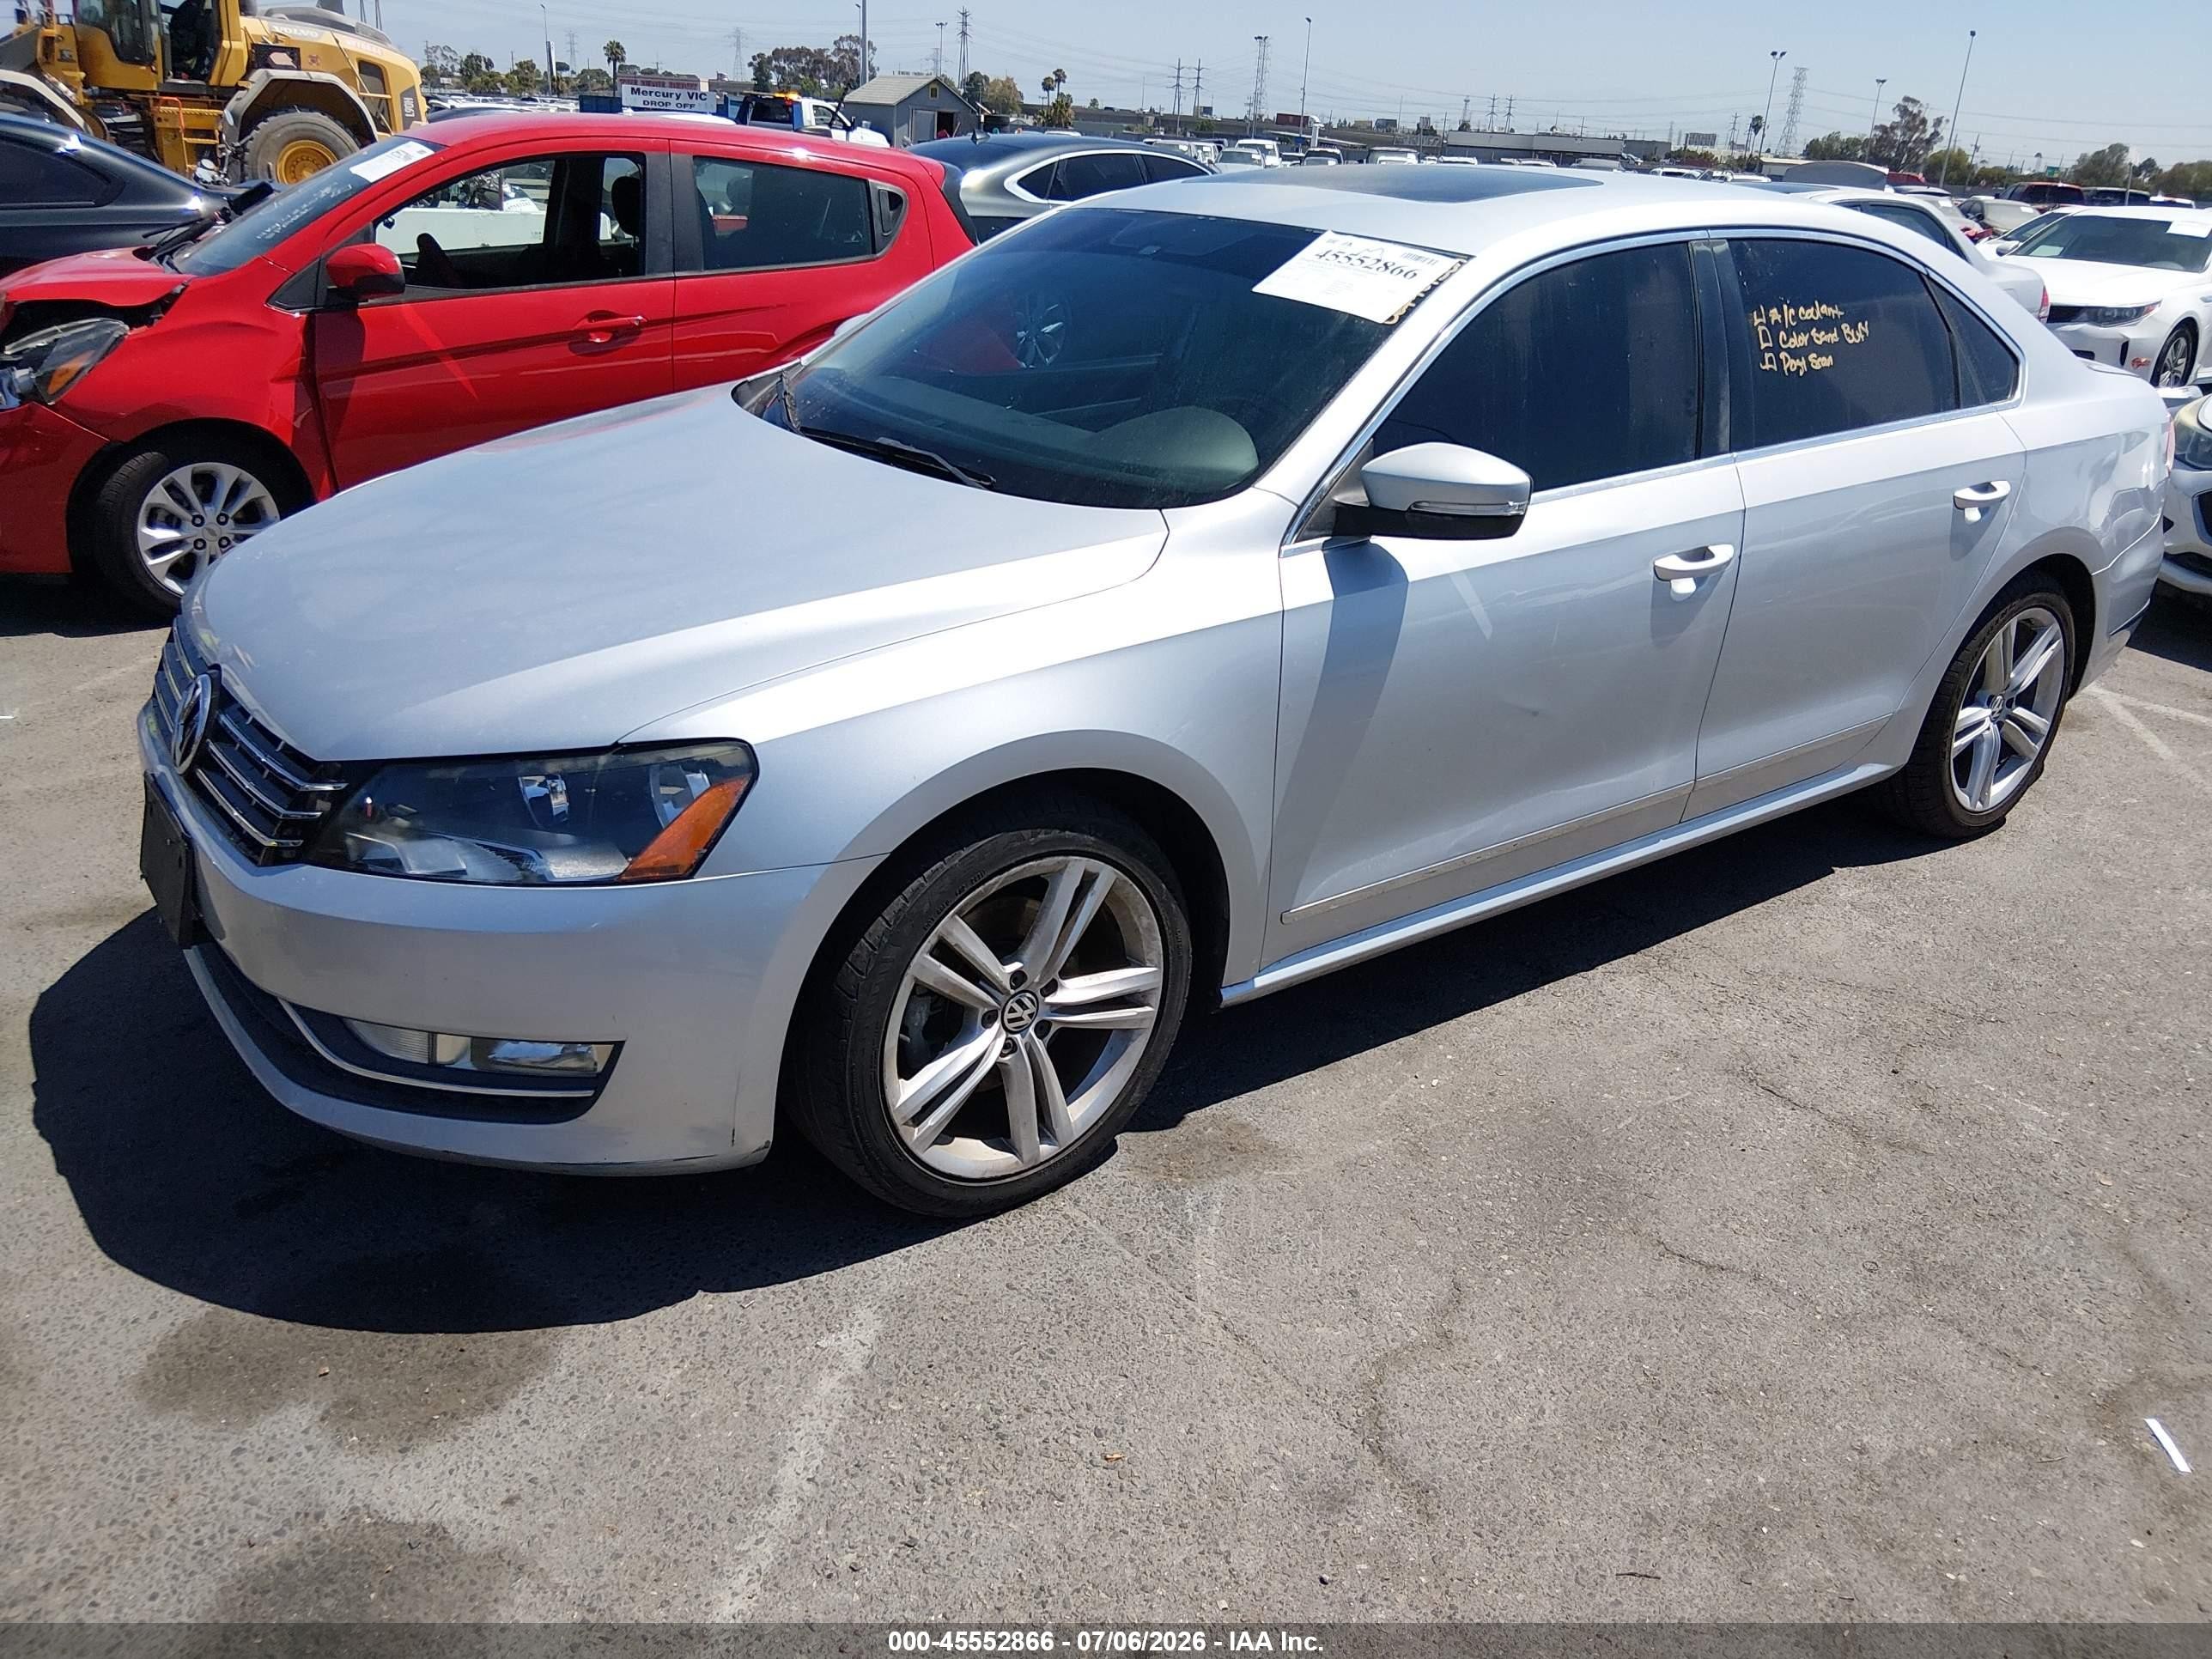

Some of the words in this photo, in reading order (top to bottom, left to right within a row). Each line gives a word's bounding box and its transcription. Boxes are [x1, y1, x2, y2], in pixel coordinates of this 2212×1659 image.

[272, 24, 320, 39] VOLVO
[630, 87, 682, 100] Mercury
[687, 91, 708, 101] VIC
[642, 99, 672, 108] DROP
[1316, 249, 1420, 280] 45552866
